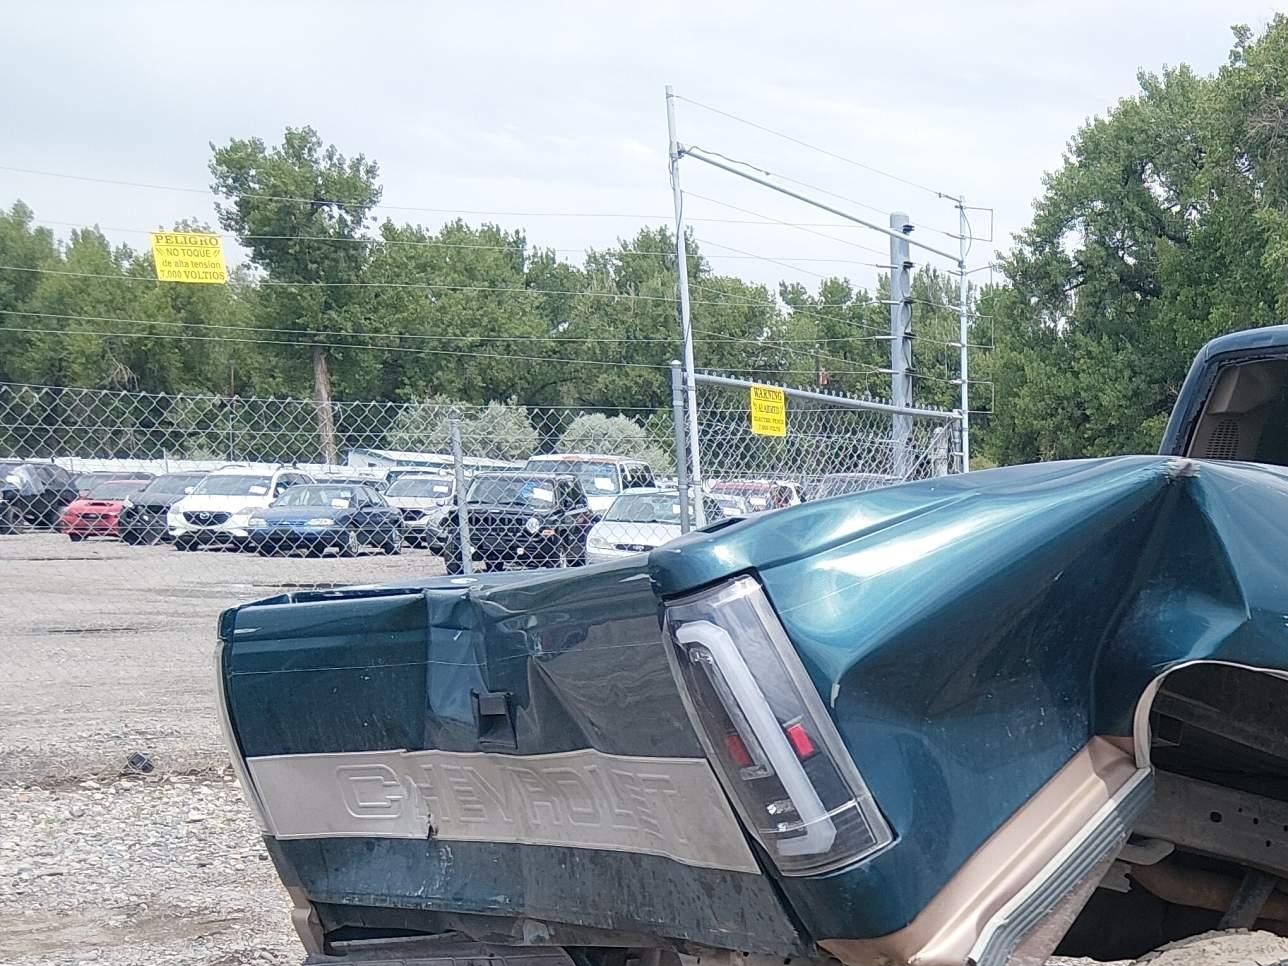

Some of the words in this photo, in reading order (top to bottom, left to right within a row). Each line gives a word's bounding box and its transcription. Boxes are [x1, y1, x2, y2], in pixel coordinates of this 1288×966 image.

[154, 234, 219, 247] PELIGRO
[166, 247, 179, 257] NO
[181, 248, 211, 258] TOQUE
[183, 270, 225, 280] VOLTIOS
[754, 387, 783, 401] WARNING
[335, 762, 691, 845] CHEVROLET
